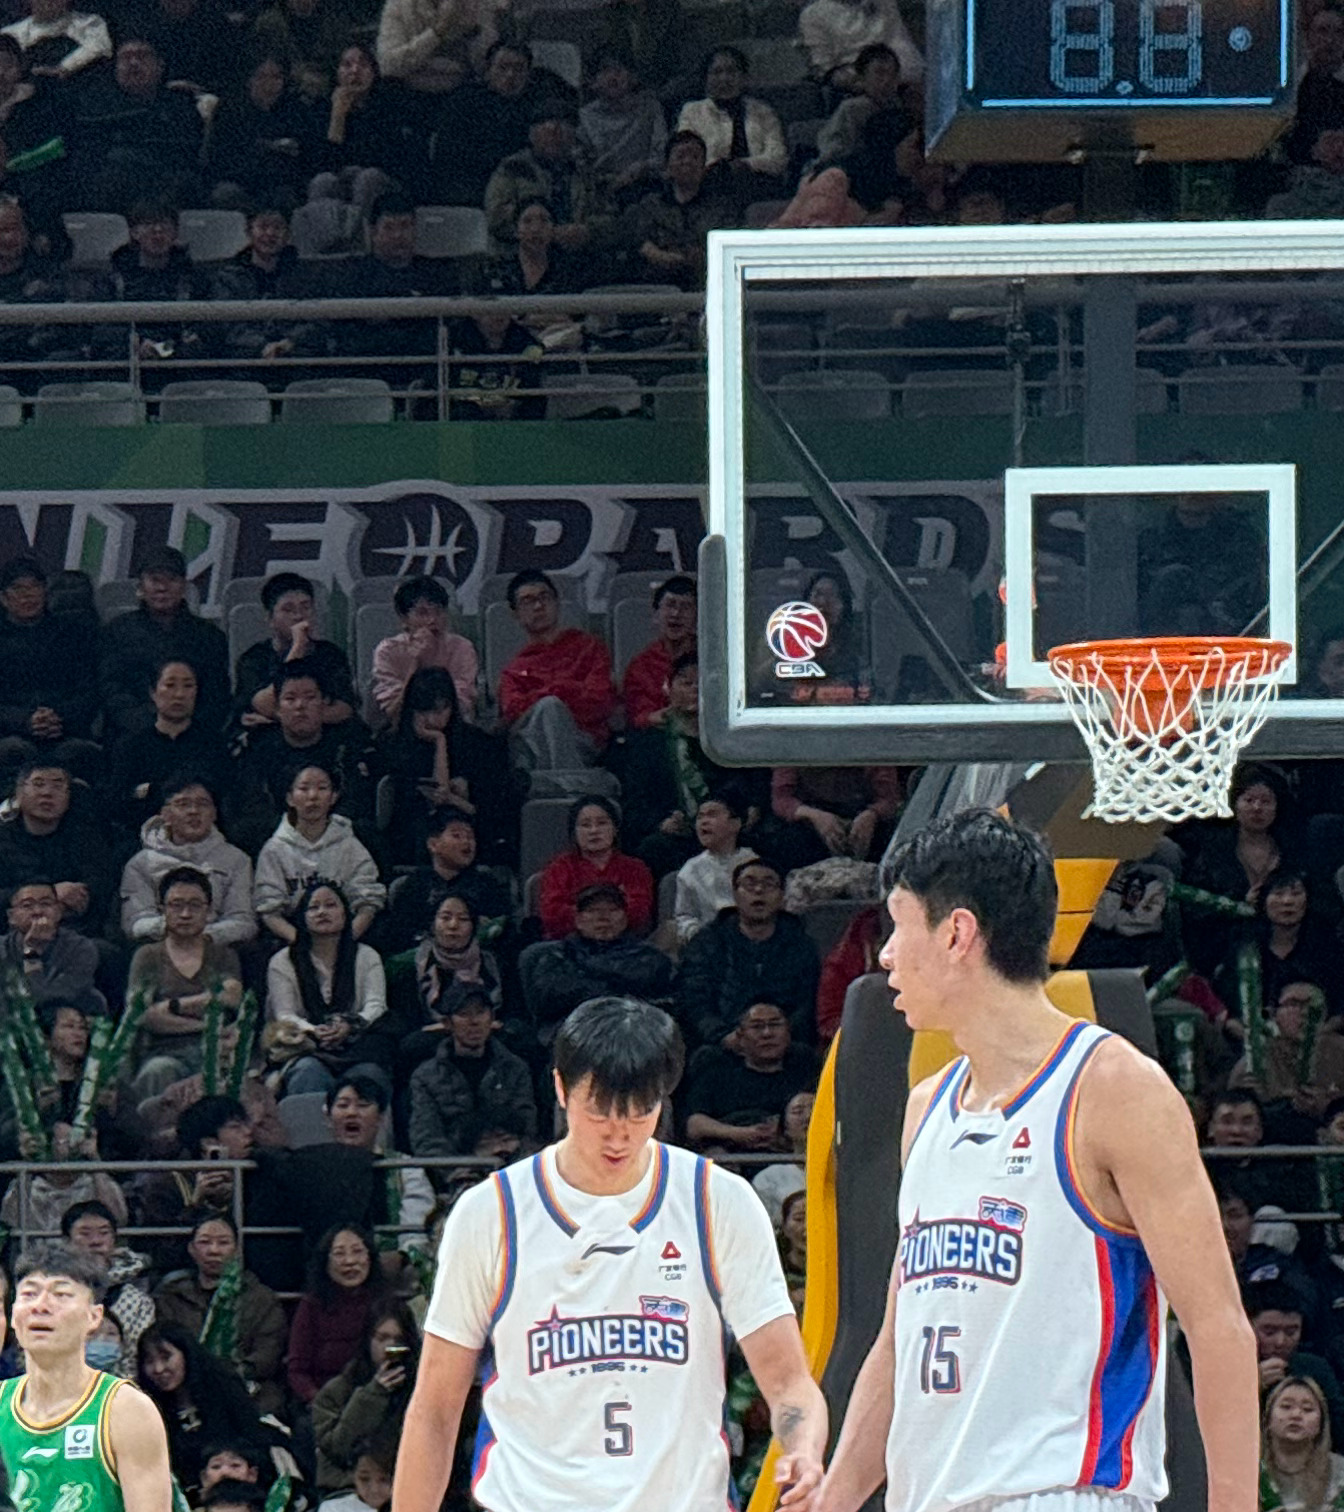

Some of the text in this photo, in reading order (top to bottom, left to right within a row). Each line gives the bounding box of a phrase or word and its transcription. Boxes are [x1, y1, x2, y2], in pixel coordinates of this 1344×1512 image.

[775, 661, 826, 678] CBA
[531, 1318, 687, 1370] PIONEERS
[920, 1325, 962, 1394] 15
[604, 1401, 633, 1457] 5
